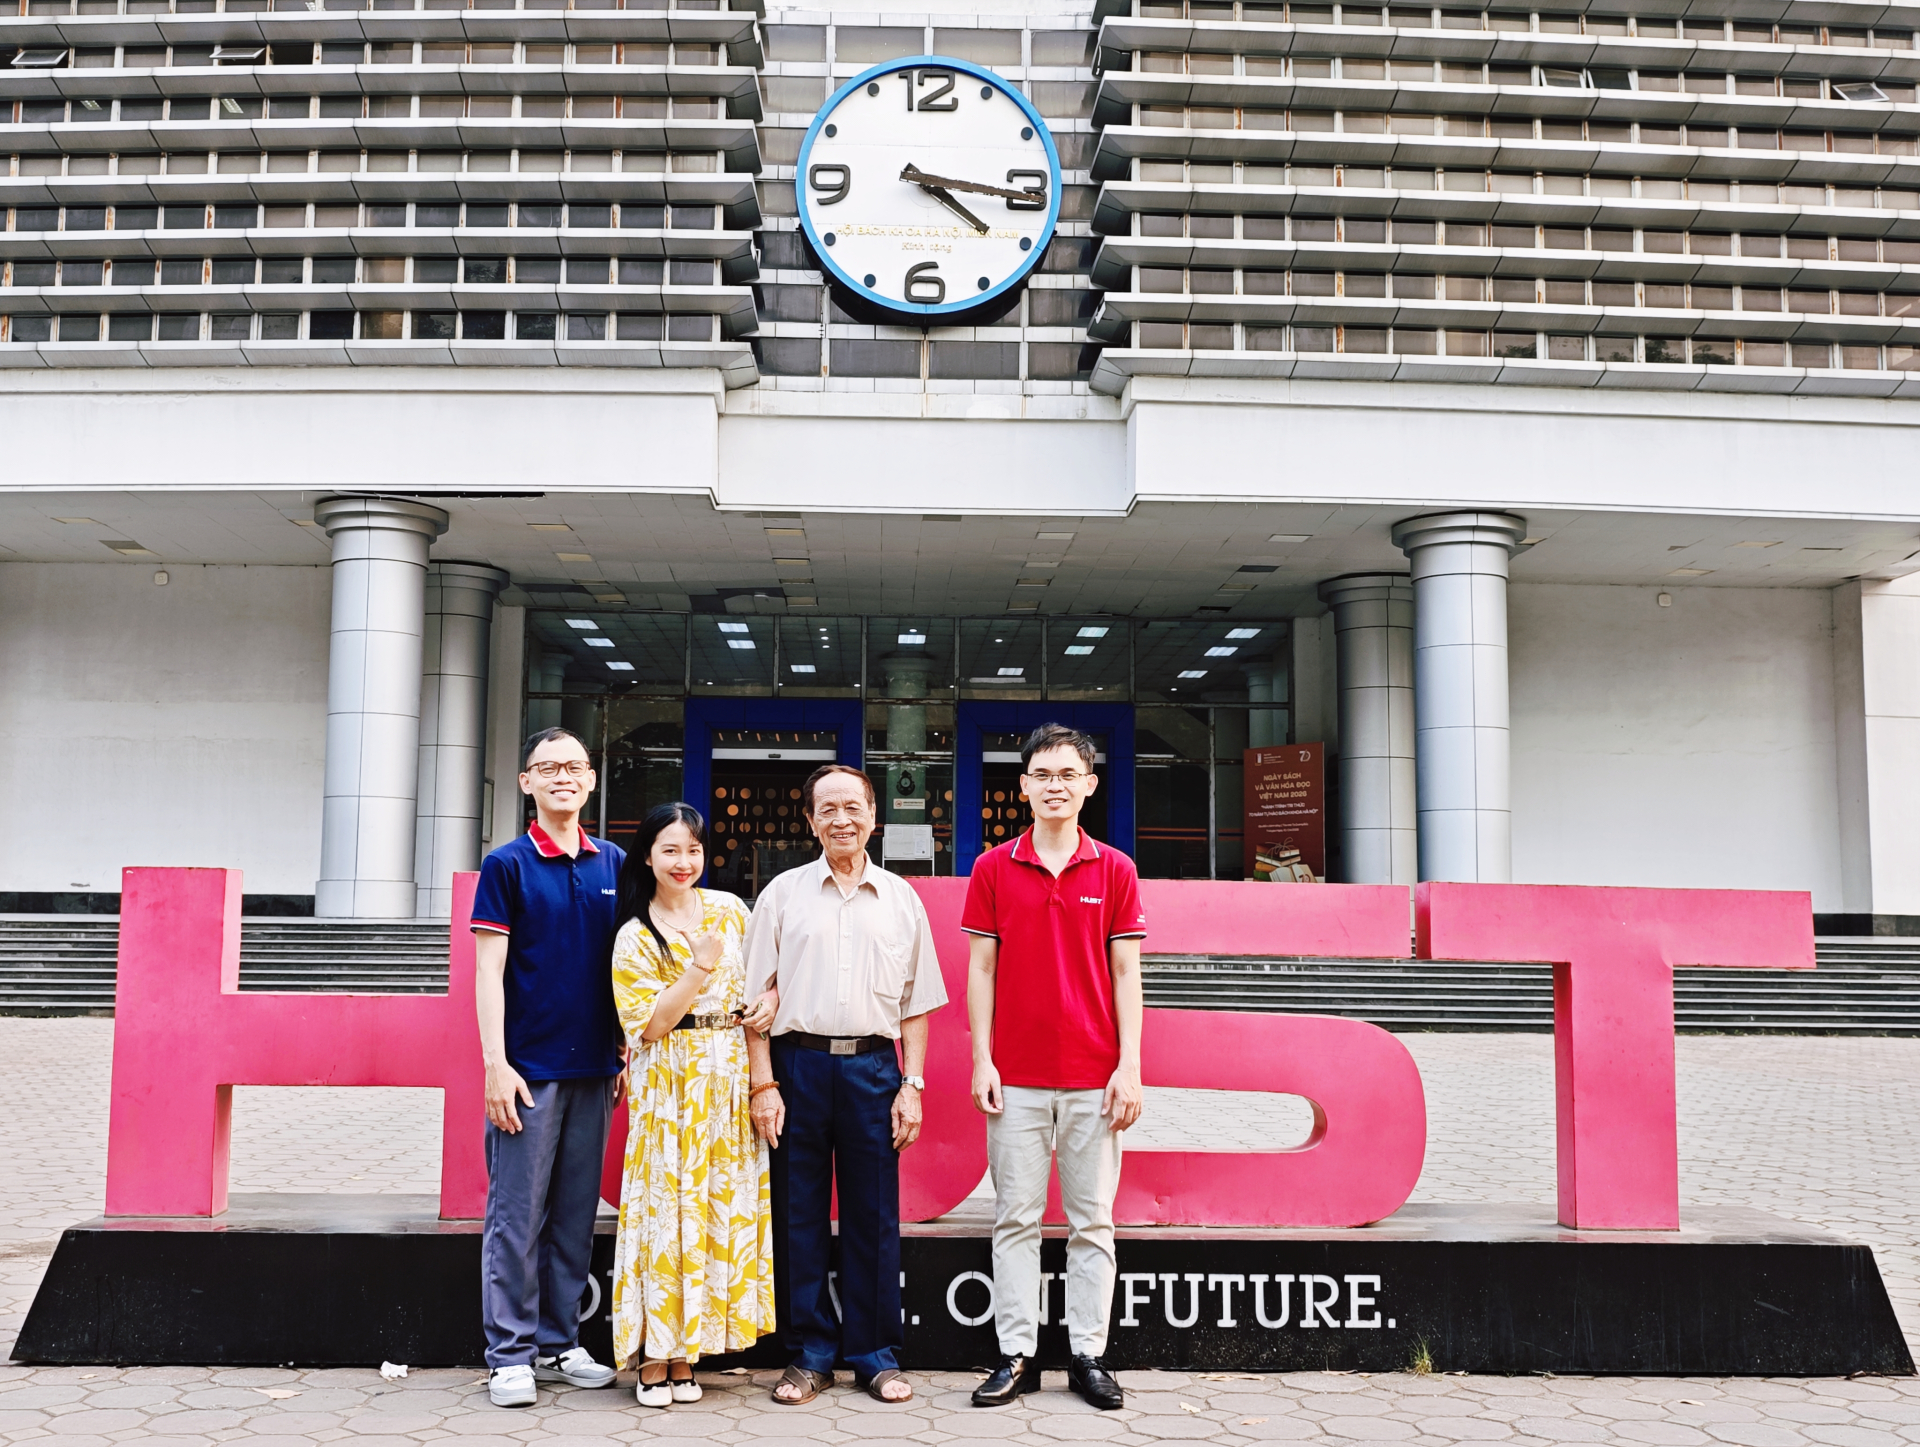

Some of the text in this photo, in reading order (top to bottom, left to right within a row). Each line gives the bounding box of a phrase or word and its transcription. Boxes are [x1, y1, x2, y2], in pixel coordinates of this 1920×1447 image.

[898, 69, 958, 112] 12
[809, 163, 851, 206] 9
[1006, 168, 1048, 211] 3
[836, 224, 854, 237] HỘI
[857, 225, 886, 236] BÁCH
[889, 227, 922, 237] KHOA
[925, 226, 940, 237] HÀ
[943, 226, 962, 239] NỘI
[995, 229, 1019, 239] NAM
[904, 261, 946, 304] 6
[1255, 781, 1310, 791] VÀ VĂN HÓA ĐỌC
[1263, 771, 1301, 781] NGÀY SÁCH
[1259, 791, 1273, 801] VIỆT
[1080, 896, 1103, 904] HUST
[1119, 1272, 1396, 1329] FUTURE.
